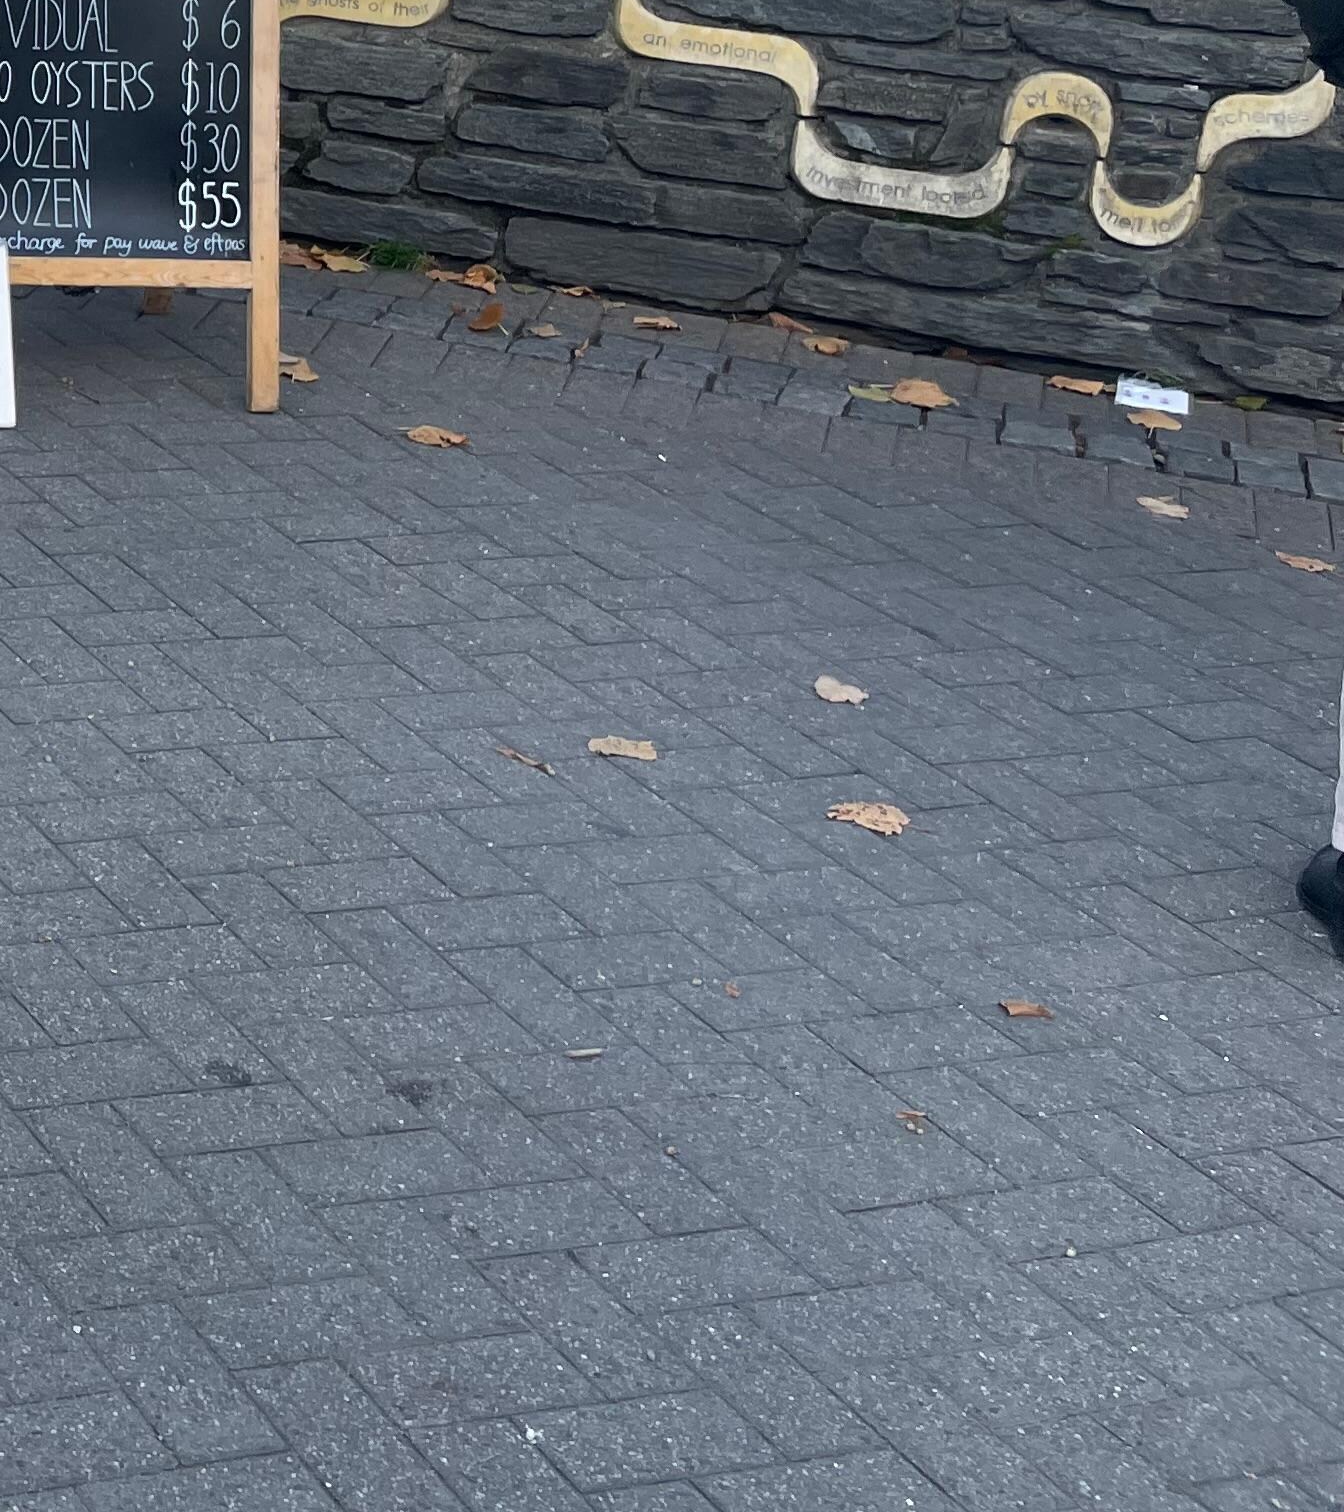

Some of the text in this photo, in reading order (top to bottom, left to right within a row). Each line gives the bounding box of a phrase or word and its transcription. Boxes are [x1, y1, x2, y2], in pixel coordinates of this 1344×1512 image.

[643, 33, 777, 64] an emotional
[31, 61, 154, 112] OYSTERS
[181, 59, 240, 116] $10
[180, 120, 240, 173] $30
[178, 178, 241, 232] $55
[74, 233, 94, 254] for
[103, 238, 131, 256] pay
[139, 239, 178, 251] wave
[184, 235, 201, 254] &
